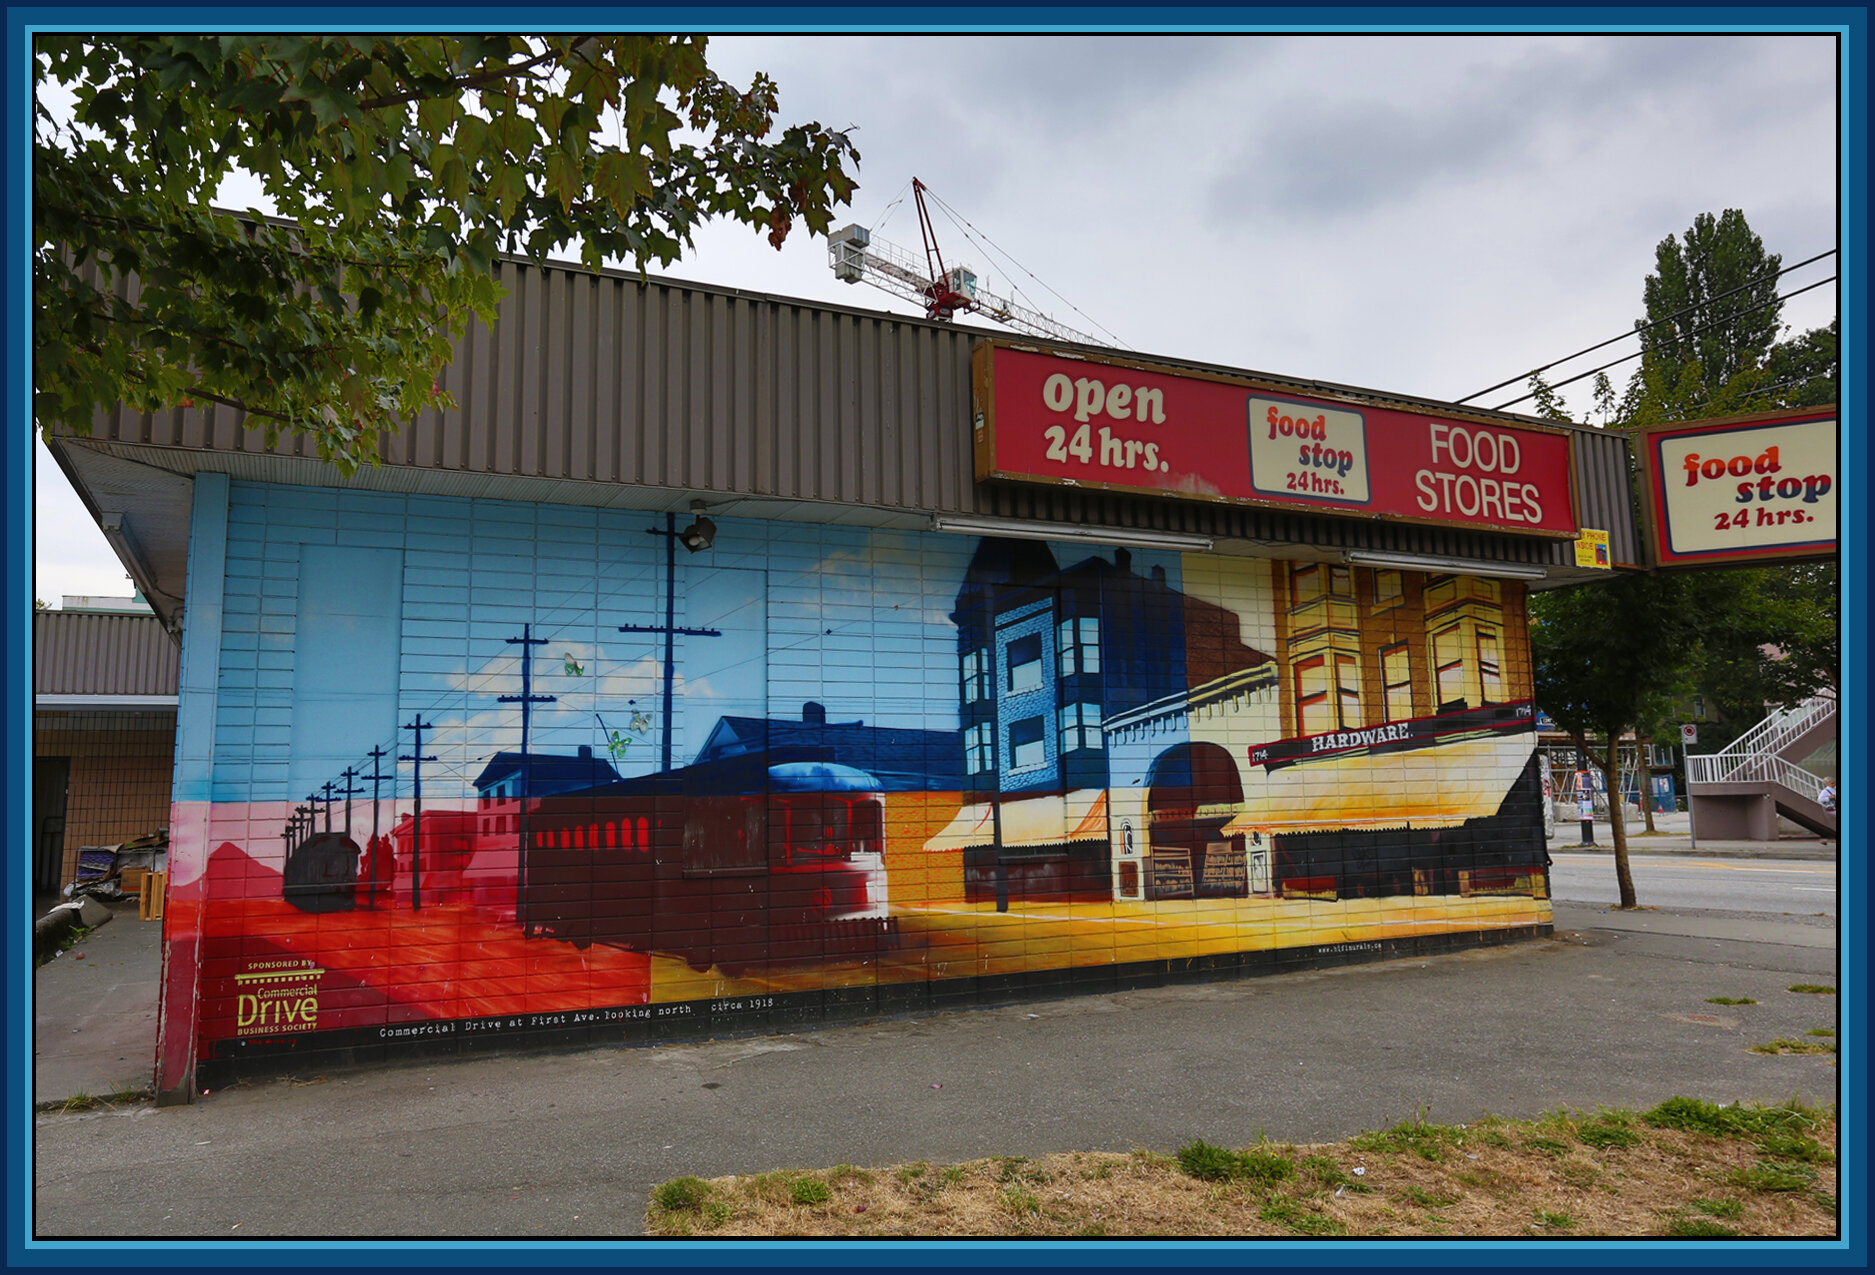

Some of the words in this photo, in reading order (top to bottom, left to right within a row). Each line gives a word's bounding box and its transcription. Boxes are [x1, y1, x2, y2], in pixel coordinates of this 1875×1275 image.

[1043, 373, 1166, 425] open
[1267, 406, 1327, 441] food
[1298, 442, 1353, 478] stop
[1430, 423, 1520, 474] FOOD
[1683, 446, 1782, 487] food
[1415, 469, 1543, 524] STORES
[1736, 474, 1832, 504] stop
[247, 960, 300, 970] SPONSORED
[301, 959, 313, 968] BY
[257, 983, 318, 999] Commercial
[237, 994, 318, 1027] Drive
[379, 1023, 456, 1038] Commercial
[465, 1019, 502, 1031] Drive
[508, 1018, 523, 1028] at
[531, 1014, 567, 1026] First
[573, 1012, 601, 1023] Ave.
[604, 1008, 651, 1020] looking
[658, 1004, 692, 1016] north
[711, 1000, 743, 1013] circa
[237, 1025, 280, 1036] BUSINESS
[281, 1022, 318, 1032] SOCIETY
